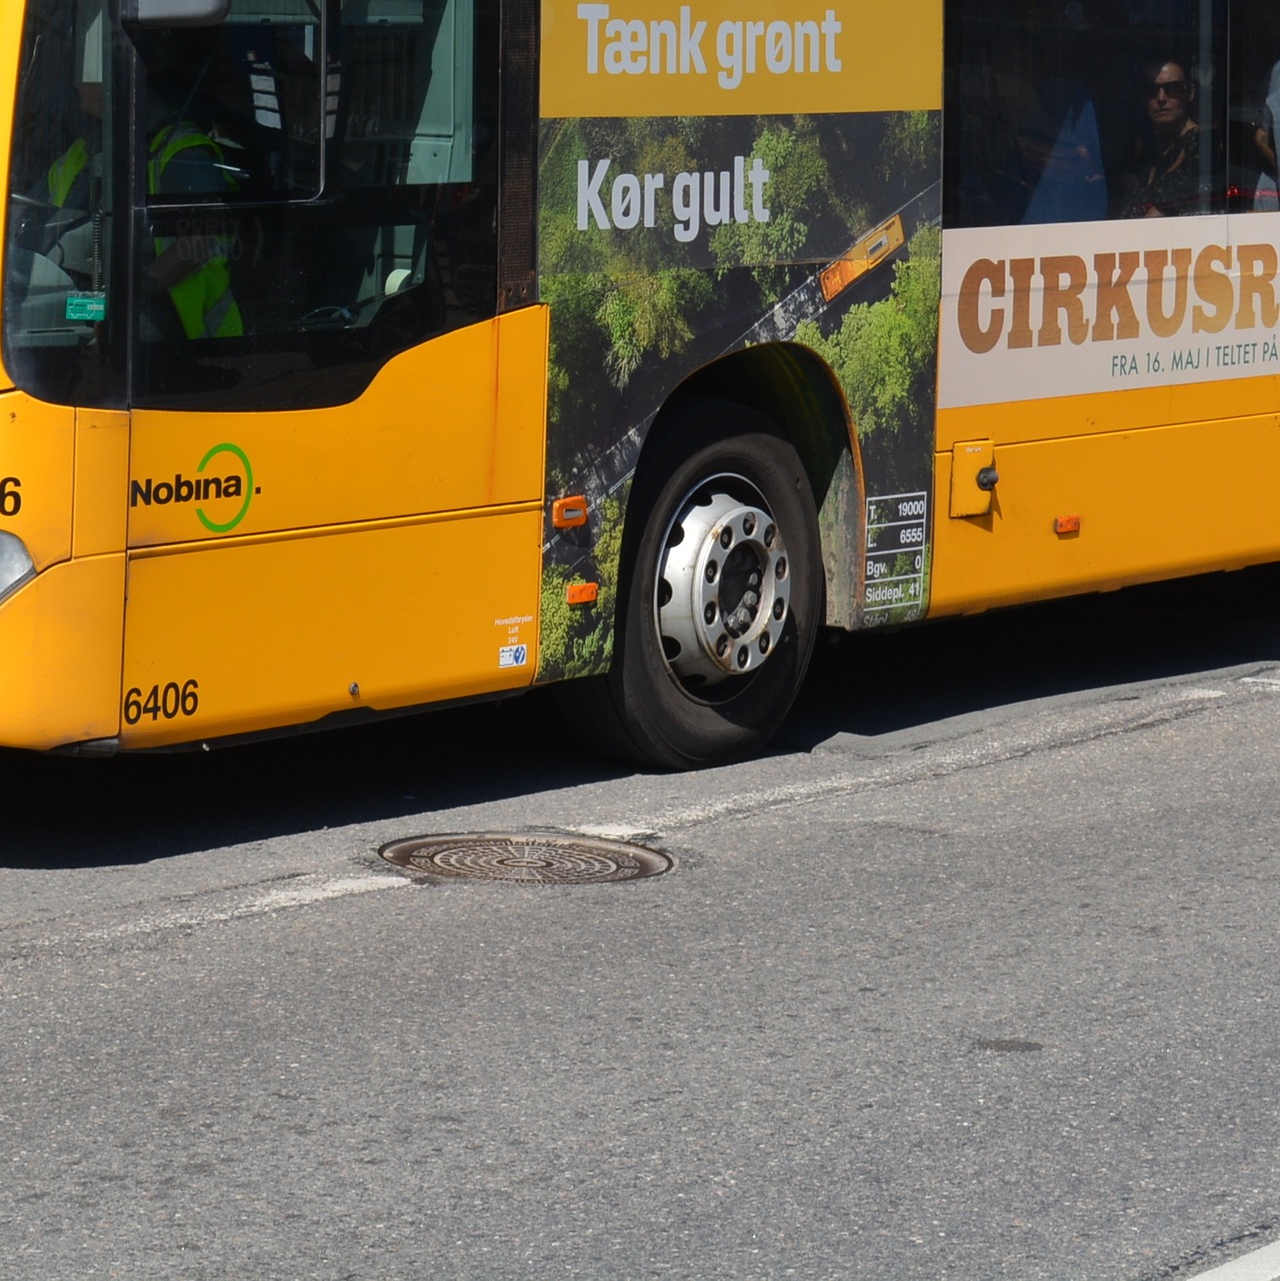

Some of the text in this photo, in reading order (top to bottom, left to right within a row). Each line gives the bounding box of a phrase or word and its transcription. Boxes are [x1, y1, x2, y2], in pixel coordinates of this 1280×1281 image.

[577, 3, 842, 89] Tænk grønt
[577, 156, 770, 242] Kør gult
[1111, 354, 1138, 377] FRA
[1146, 352, 1165, 374] 16.
[1171, 348, 1201, 371] MAJ
[1215, 343, 1258, 367] TELTET
[1262, 334, 1278, 362] PÅ
[898, 500, 924, 517] 19000
[900, 528, 923, 543] 6555
[867, 555, 922, 578] Bgv. 0
[865, 583, 920, 602] Siddepl. 41
[124, 679, 199, 725] 6406
